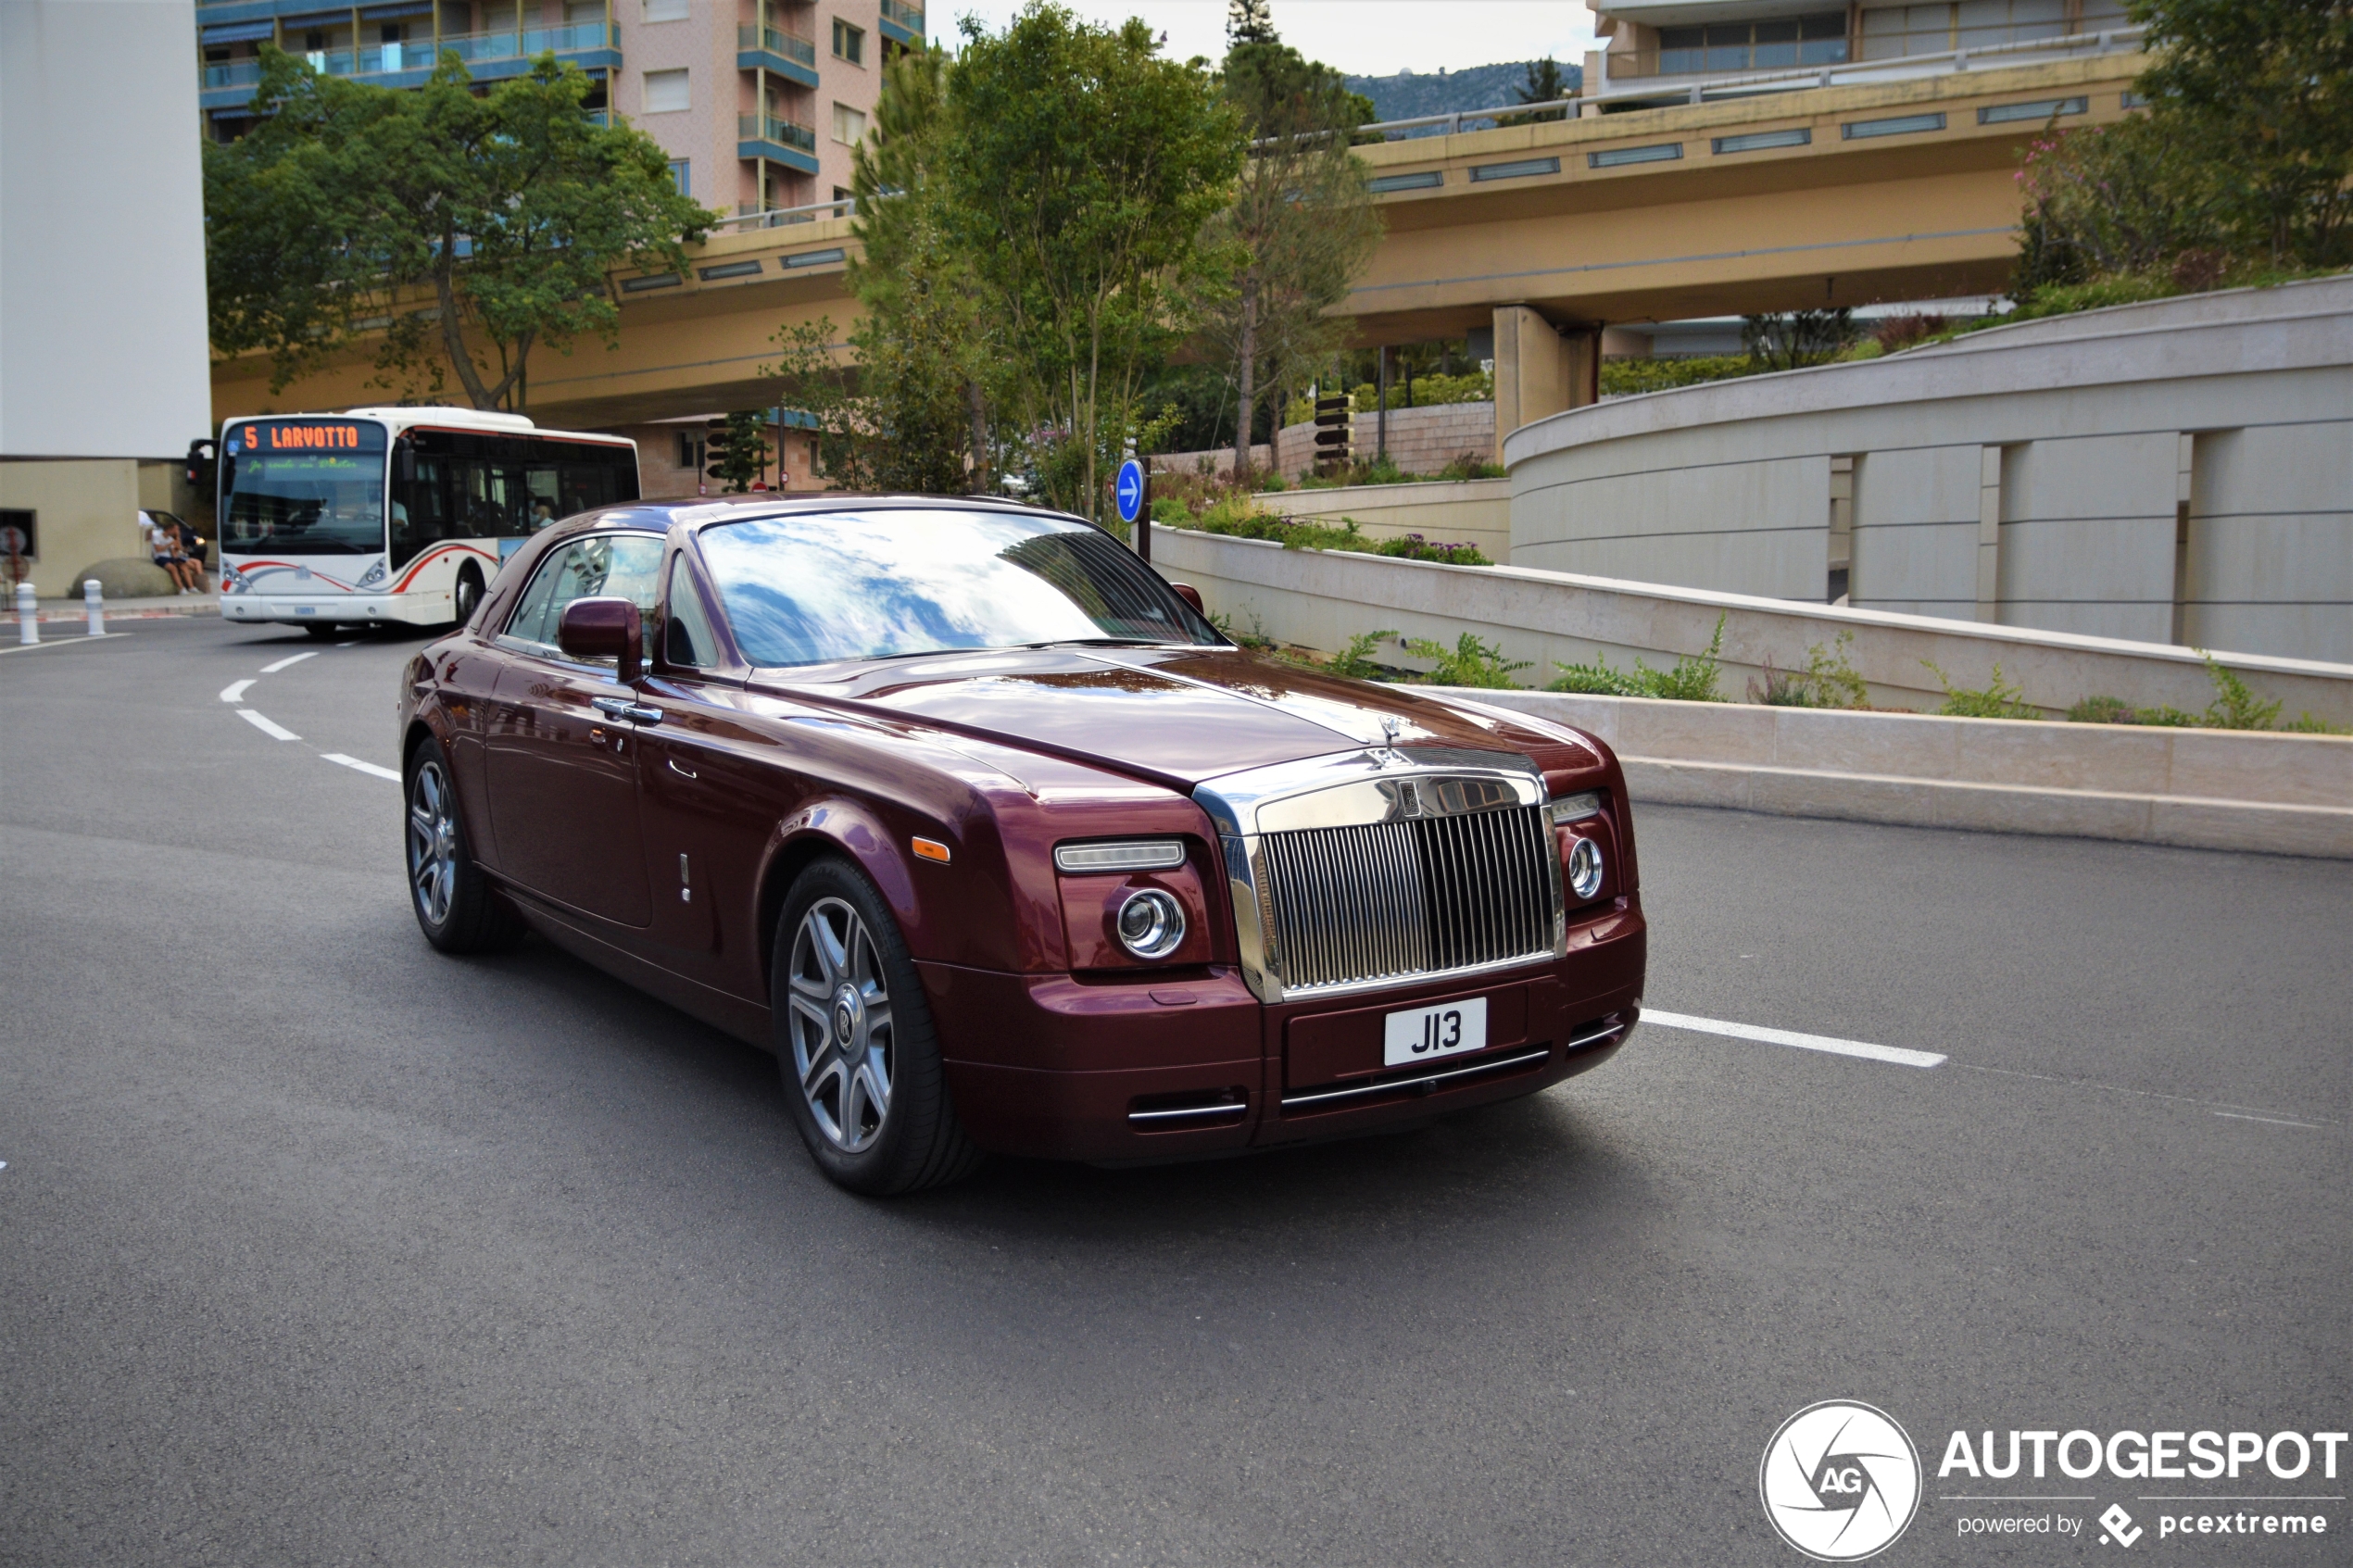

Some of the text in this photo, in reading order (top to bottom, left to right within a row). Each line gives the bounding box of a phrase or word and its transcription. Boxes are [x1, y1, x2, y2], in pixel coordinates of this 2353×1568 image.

[244, 425, 359, 449] 5 LARVOTTO
[1411, 1010, 1461, 1054] J13
